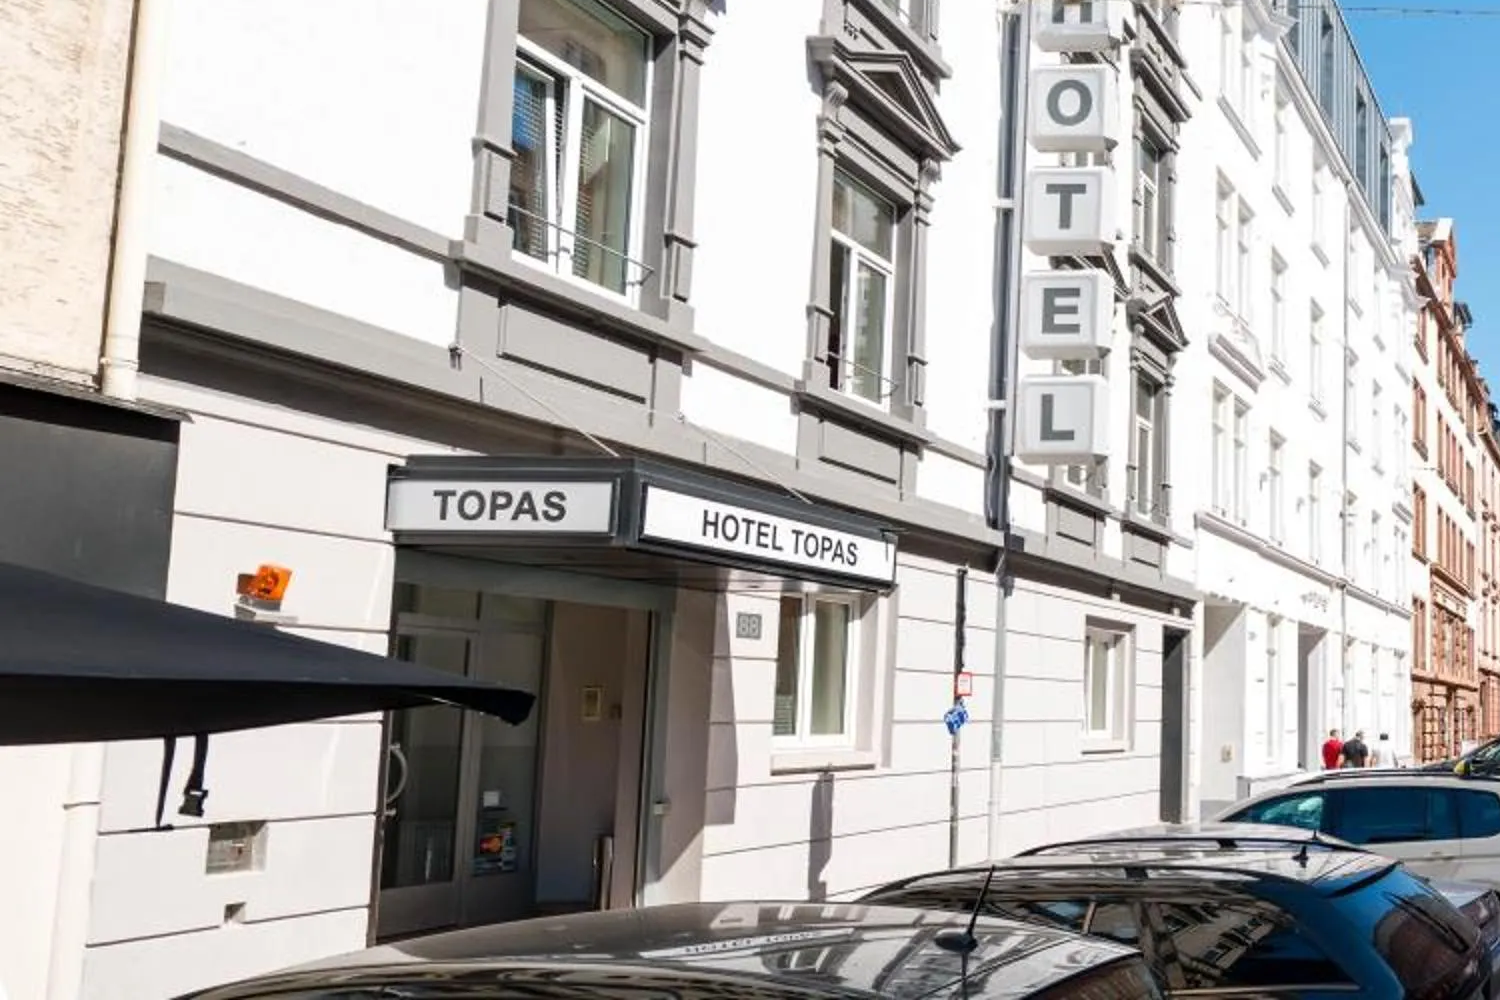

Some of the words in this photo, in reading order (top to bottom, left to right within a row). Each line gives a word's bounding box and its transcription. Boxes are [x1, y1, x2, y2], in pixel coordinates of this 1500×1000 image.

[433, 489, 567, 523] TOPAS
[702, 509, 784, 551] HOTEL
[791, 529, 859, 567] TOPAS
[739, 615, 759, 636] 88
